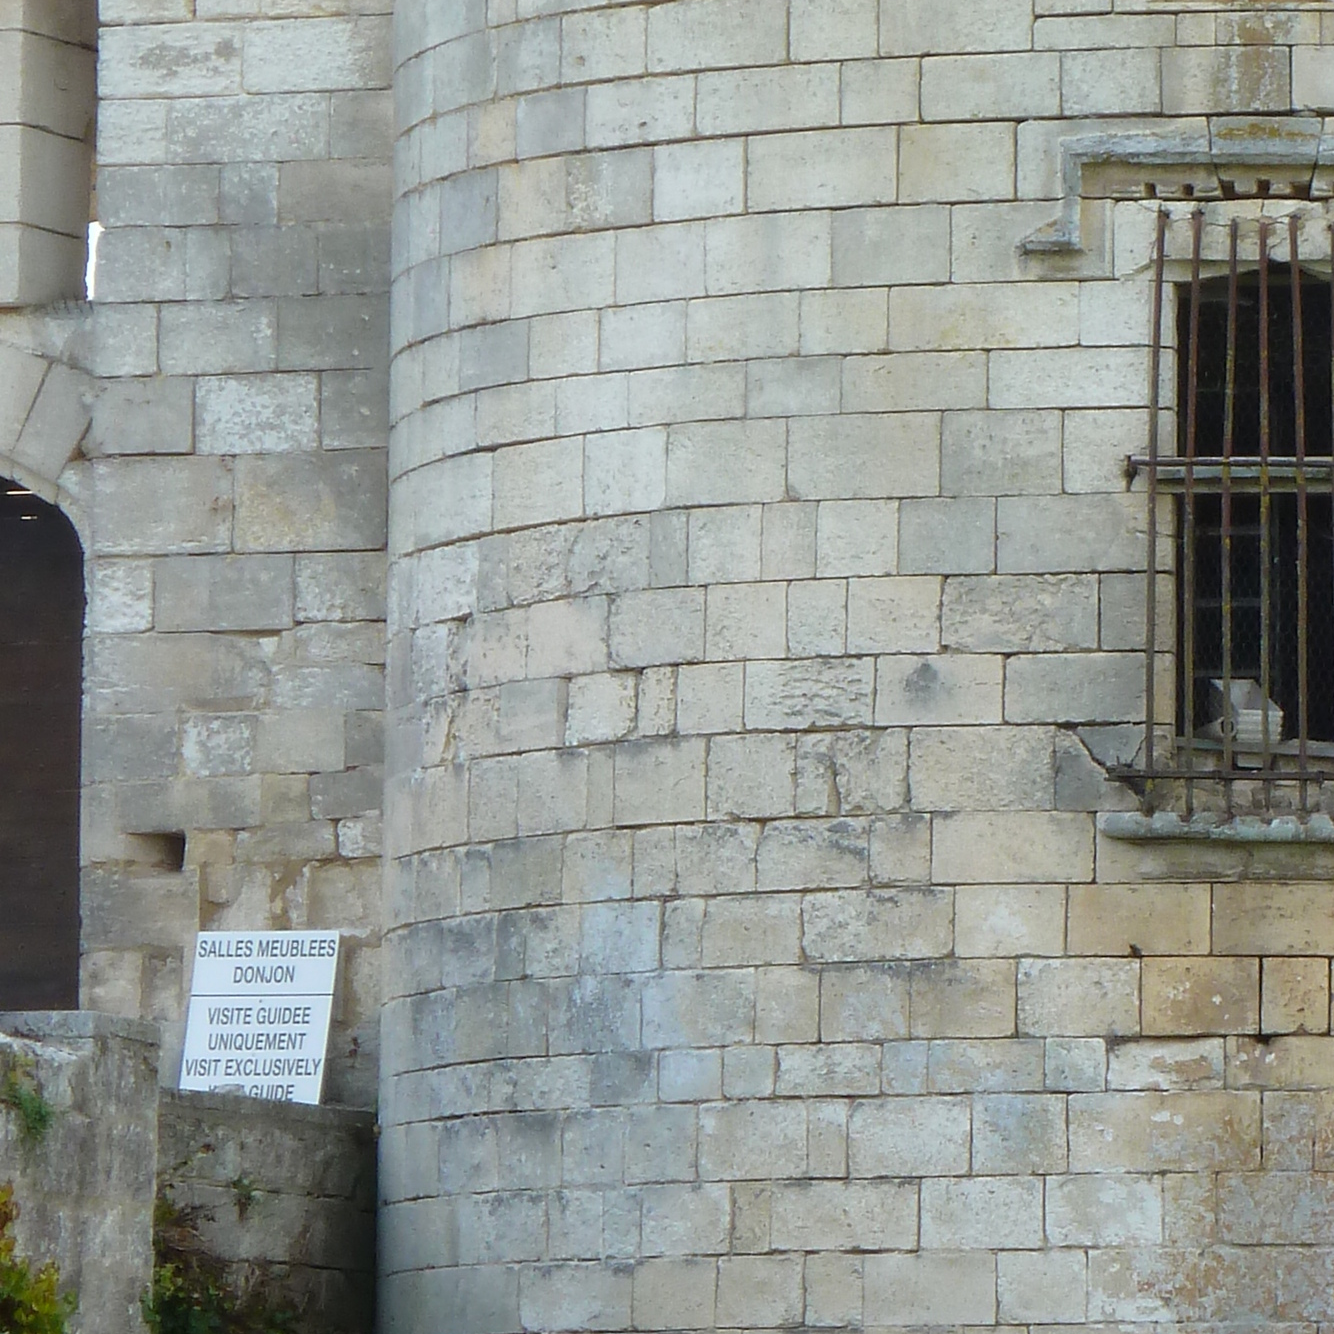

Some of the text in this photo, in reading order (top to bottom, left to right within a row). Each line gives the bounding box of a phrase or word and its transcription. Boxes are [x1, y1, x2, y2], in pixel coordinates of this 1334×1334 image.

[198, 939, 336, 957] SALLES MEUBLEES
[233, 965, 295, 984] DONJON
[208, 1007, 311, 1025] VISITE GUIDEE
[208, 1033, 306, 1051] UNIQUEMENT
[185, 1058, 321, 1076] VISIT EXCLUSIVELY
[249, 1084, 294, 1101] GUIDE
